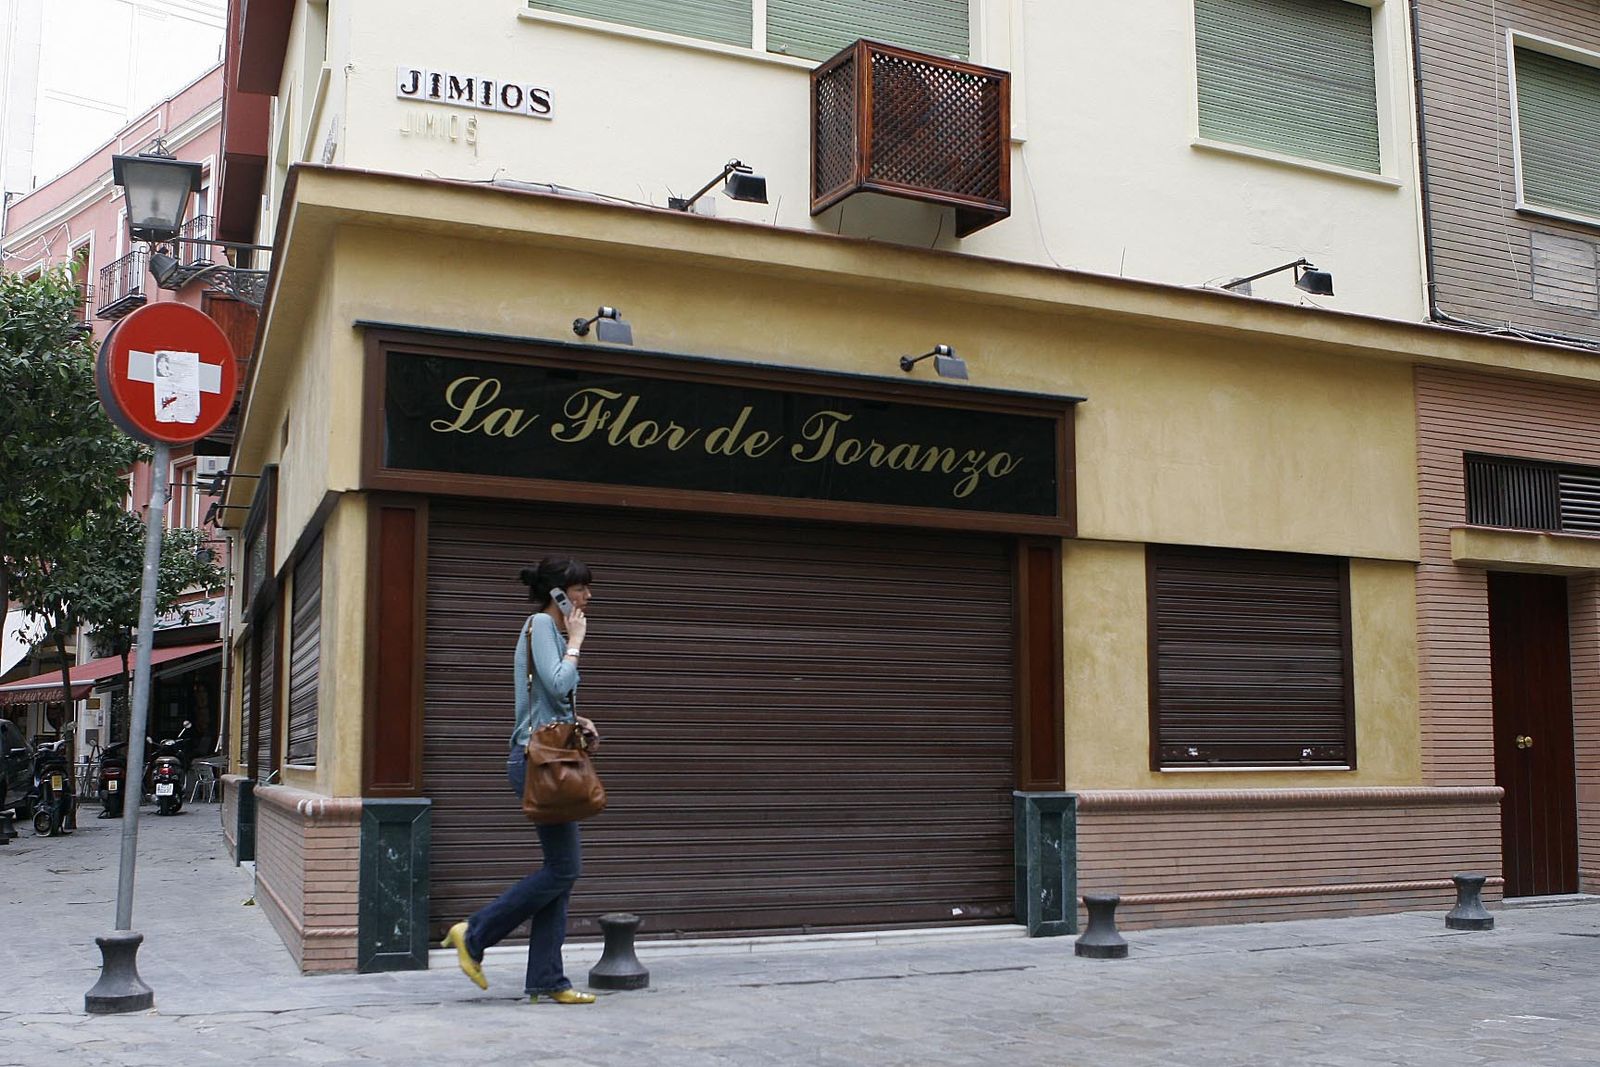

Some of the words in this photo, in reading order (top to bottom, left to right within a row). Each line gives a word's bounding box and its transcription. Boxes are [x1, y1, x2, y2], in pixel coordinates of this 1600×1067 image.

[400, 69, 551, 114] JIMIOS
[429, 376, 540, 438] La
[550, 387, 701, 451] Flor
[704, 406, 784, 457] de
[791, 410, 1024, 498] Toranzo
